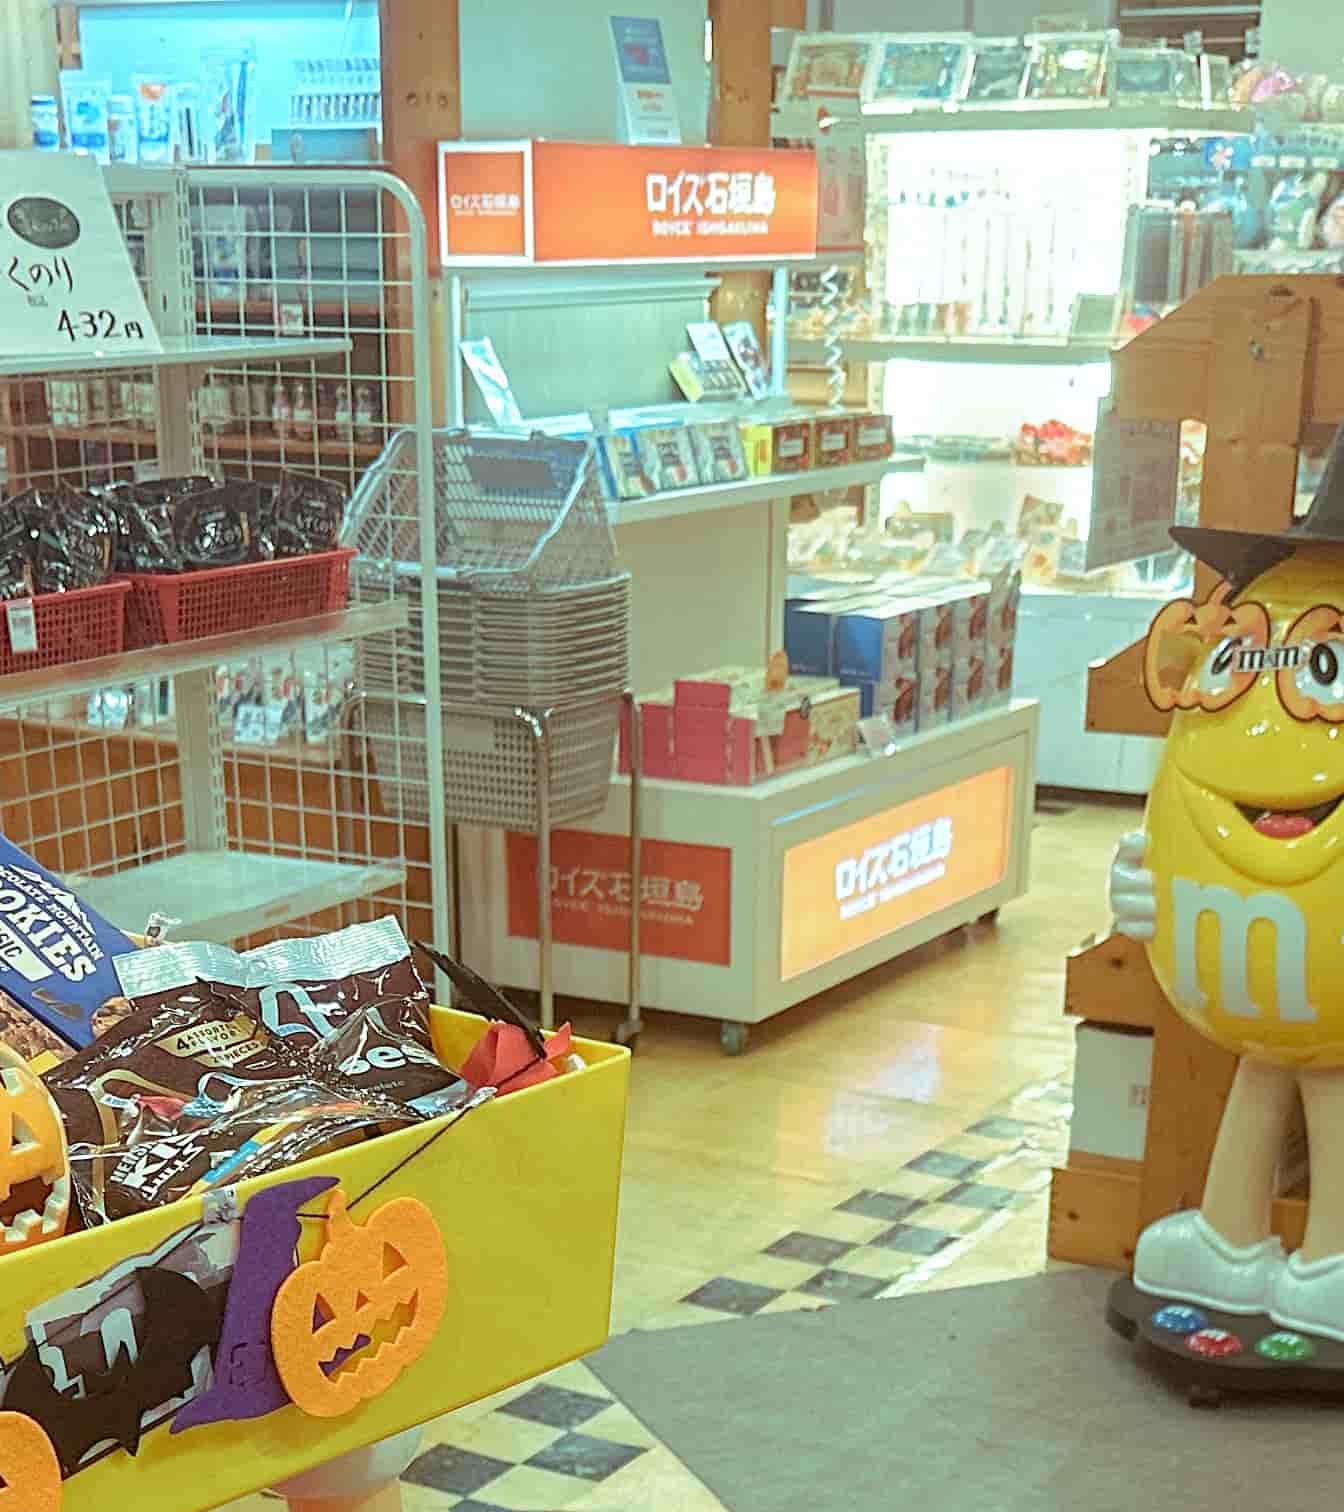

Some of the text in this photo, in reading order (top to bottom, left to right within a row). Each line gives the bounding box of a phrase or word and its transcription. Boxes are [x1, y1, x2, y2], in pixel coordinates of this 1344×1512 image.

[645, 171, 775, 215] ロイズ石垣島
[834, 816, 953, 902] ロイズ石垣島
[43, 899, 105, 961] MOUNTAIN
[1171, 879, 1319, 1025] m
[176, 1037, 191, 1051] 4
